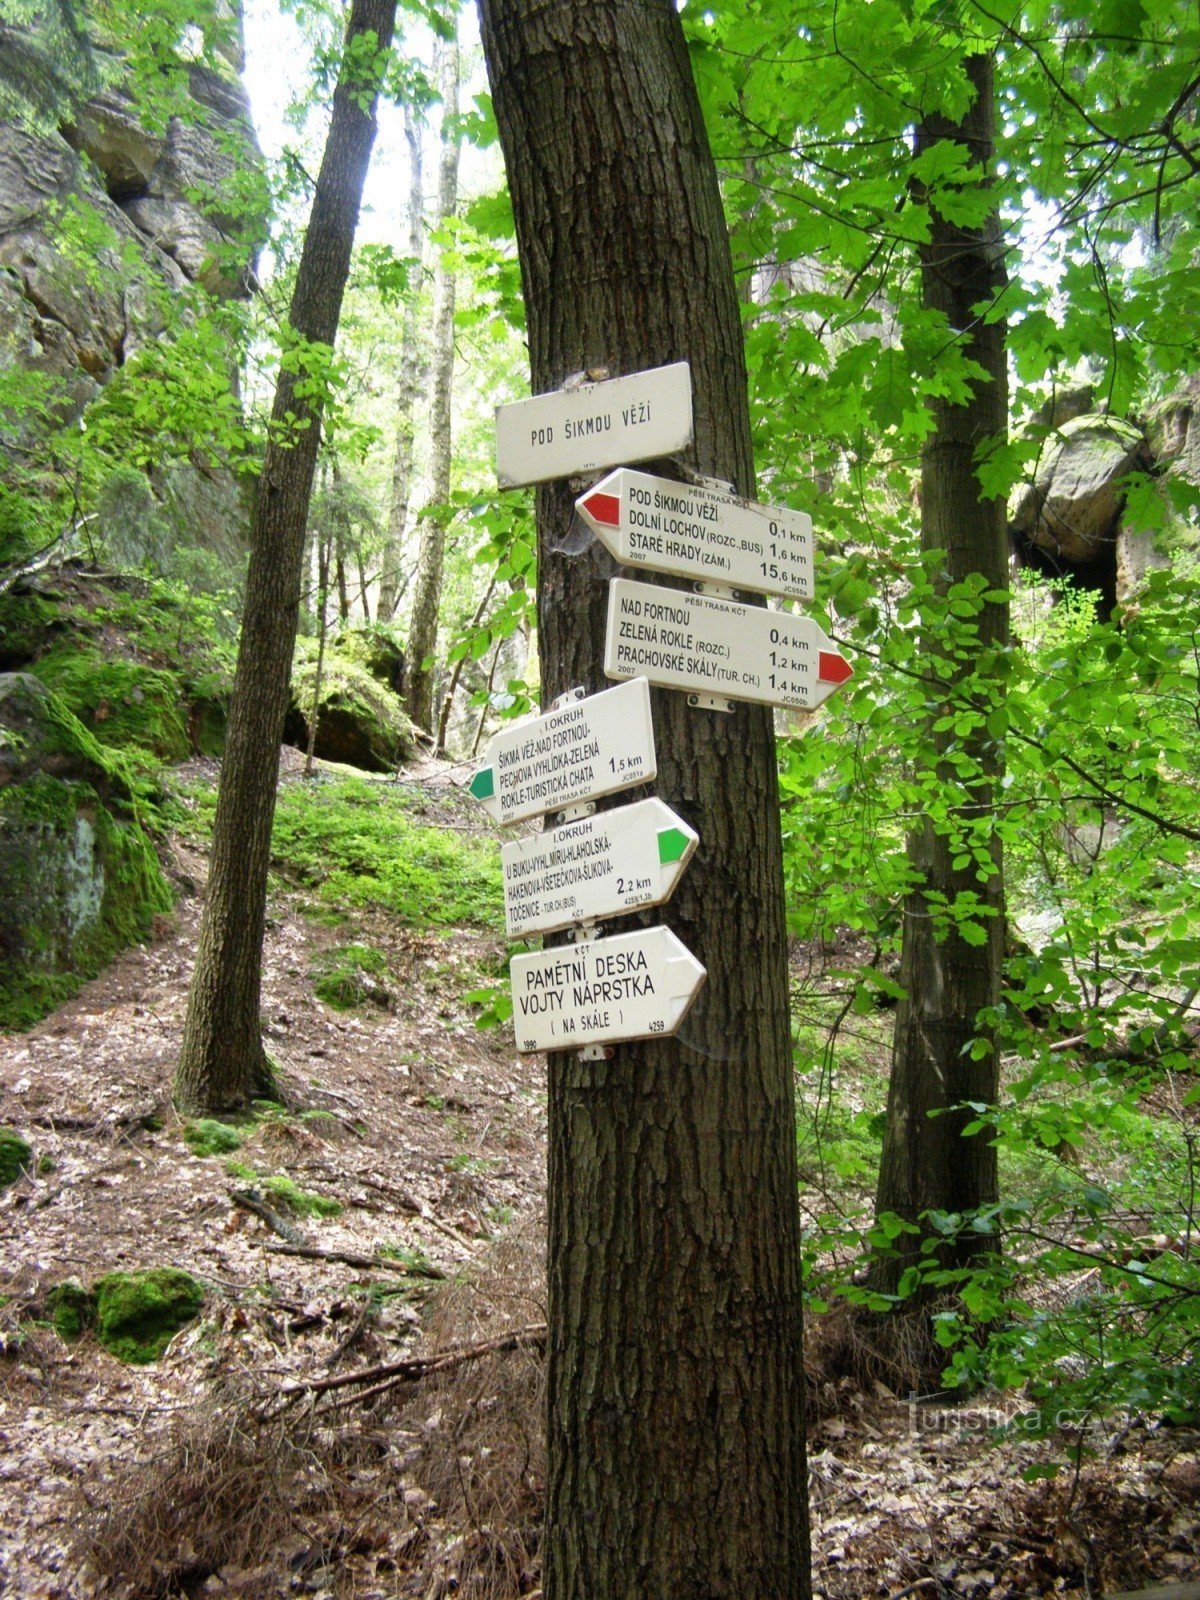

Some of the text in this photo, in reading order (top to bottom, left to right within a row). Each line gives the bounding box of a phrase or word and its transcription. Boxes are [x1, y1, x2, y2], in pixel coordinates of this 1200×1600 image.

[532, 400, 651, 446] POD ŠIKMOU VĚŽÍ
[707, 494, 730, 504] TRASA
[630, 488, 806, 543] POD ŠIKMOU VĚŽÍ 0,1 km
[630, 510, 660, 530] DOLNÍ
[770, 543, 787, 559] 1,6
[791, 552, 806, 564] km
[630, 552, 646, 560] 2007
[630, 532, 662, 553] STARÉ
[760, 562, 787, 581] 15,6
[792, 574, 807, 585] km
[686, 597, 747, 616] PĚŠÍ TRASA KČT
[621, 598, 809, 650] NAD FORTNOU 0,4 km
[620, 621, 808, 672] ZELENÁ ROKLE (ROZC.) 1,2 km
[618, 645, 684, 672] PRACHOVSKÉ
[743, 673, 760, 688] CH.)
[769, 674, 787, 691] 1,4
[791, 683, 807, 694] km
[618, 665, 808, 705] 2007 JC050b
[499, 745, 520, 769] ŠIKMÁ
[553, 723, 590, 749] FORTNOU-
[500, 766, 532, 789] PECHOVA
[570, 766, 594, 787] CHATA
[609, 756, 625, 772] 1,5
[628, 756, 642, 768] km
[559, 791, 578, 803] TRASA
[580, 786, 591, 795] KČT
[503, 812, 514, 821] 2007
[507, 864, 511, 879] U
[617, 878, 633, 894] 2.2
[636, 879, 651, 889] km
[510, 901, 540, 922] TOČENICE
[575, 945, 589, 955] KČT
[527, 950, 647, 990] PAMĚTNÍ DESKA
[520, 974, 654, 1015] VOJTY NÁPRSTKA
[524, 1021, 664, 1049] 1990 4259
[563, 1020, 575, 1033] NA
[582, 1009, 610, 1030] SKÁLE
